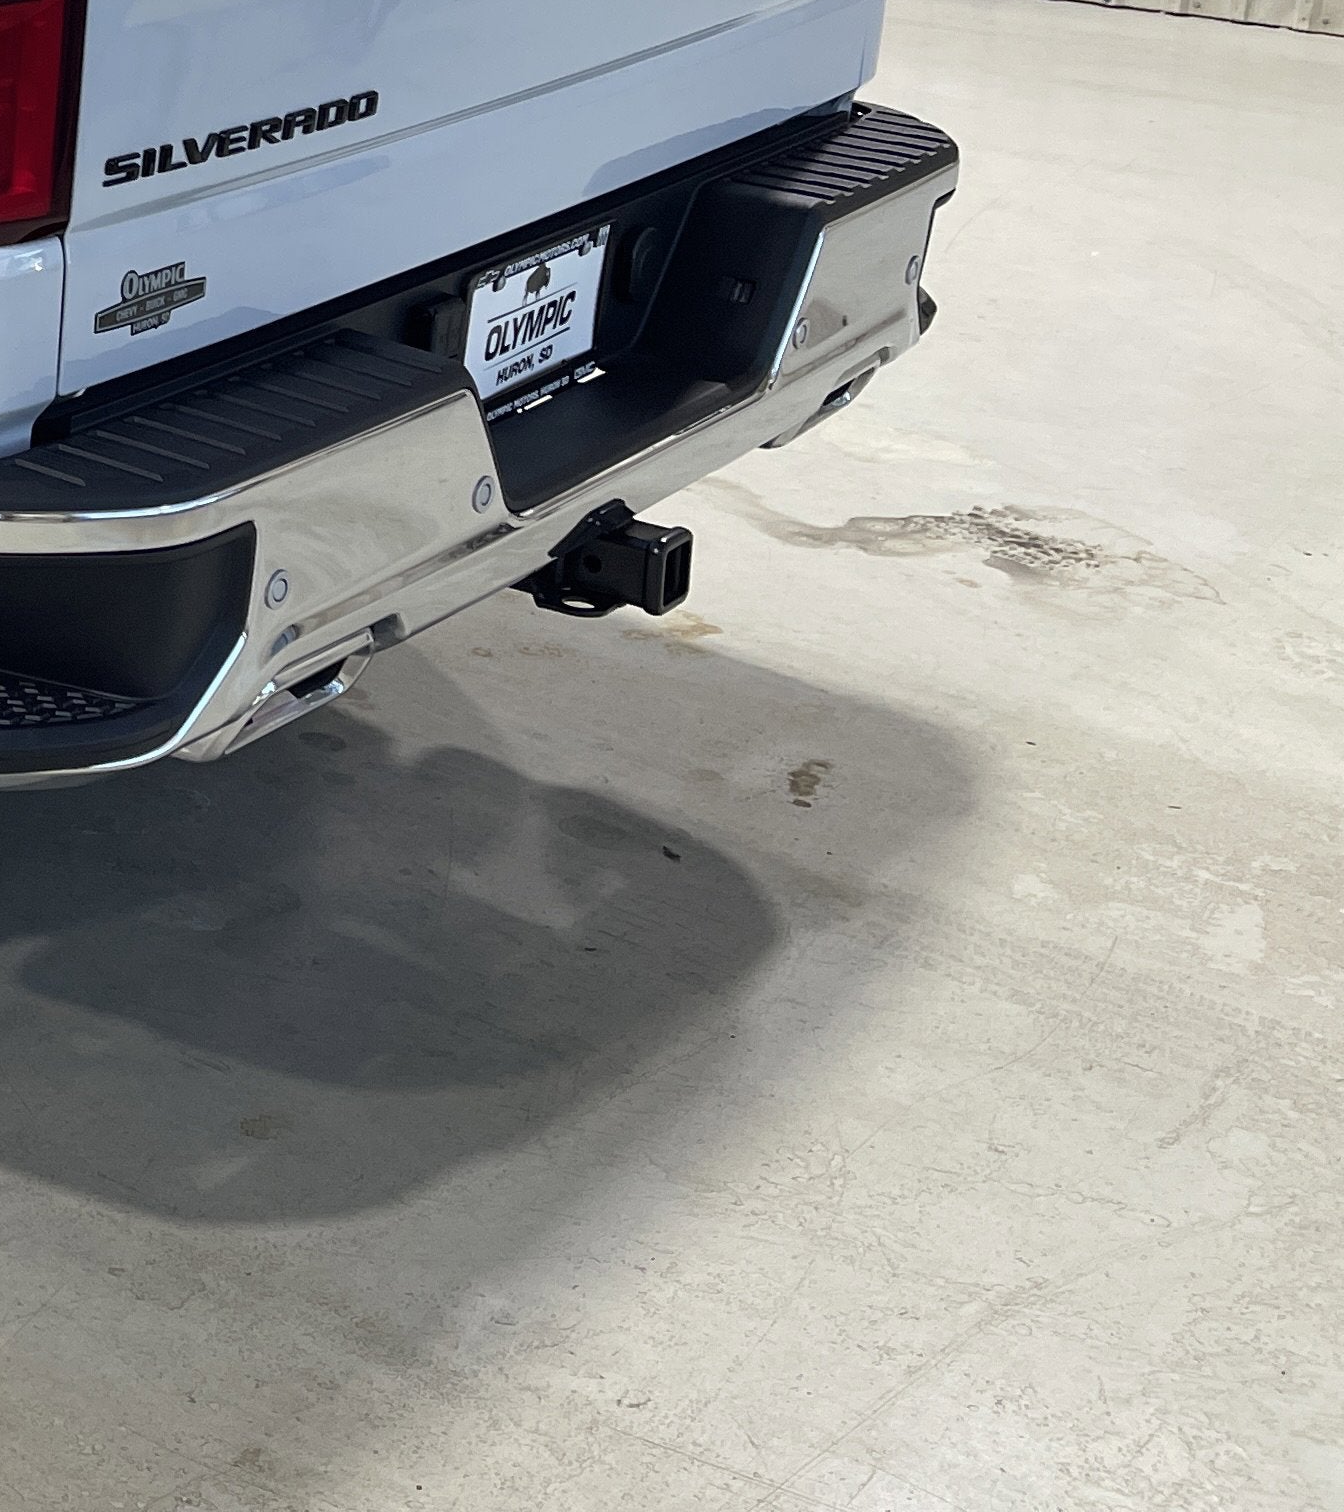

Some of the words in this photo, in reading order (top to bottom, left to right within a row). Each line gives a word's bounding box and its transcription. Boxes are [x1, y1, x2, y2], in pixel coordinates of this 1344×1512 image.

[102, 90, 380, 188] SILVERADO
[122, 263, 186, 300] OLYMPIC
[484, 290, 577, 362] OLYMPIC
[495, 354, 535, 386] HURON,
[538, 344, 553, 364] SD
